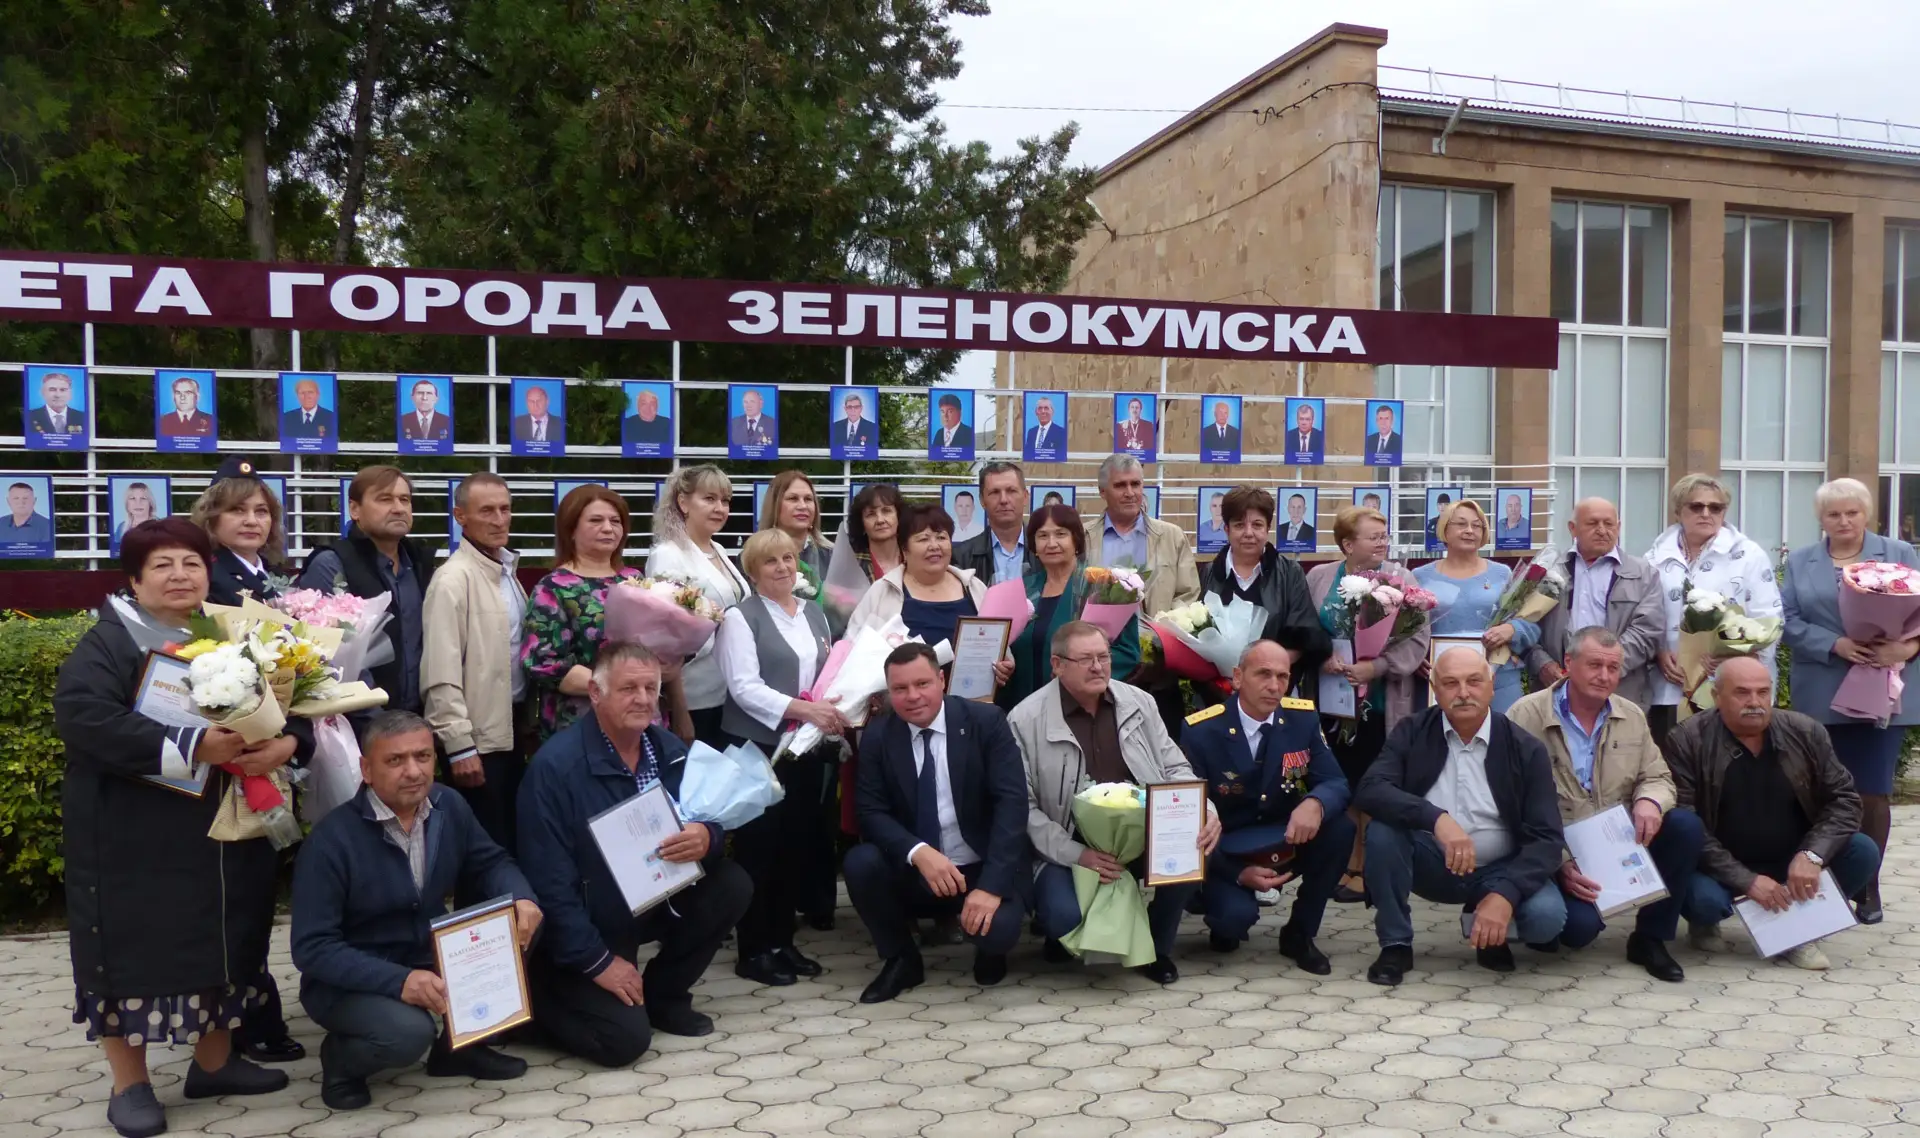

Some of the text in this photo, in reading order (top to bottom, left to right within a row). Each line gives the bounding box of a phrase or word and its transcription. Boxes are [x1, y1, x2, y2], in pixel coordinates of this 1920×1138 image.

[0, 260, 1367, 355] ЕТА ГОРОДА ЗЕЛЕНОКУМСКА
[448, 934, 506, 958] БЛАГОДАРНОСТЬ
